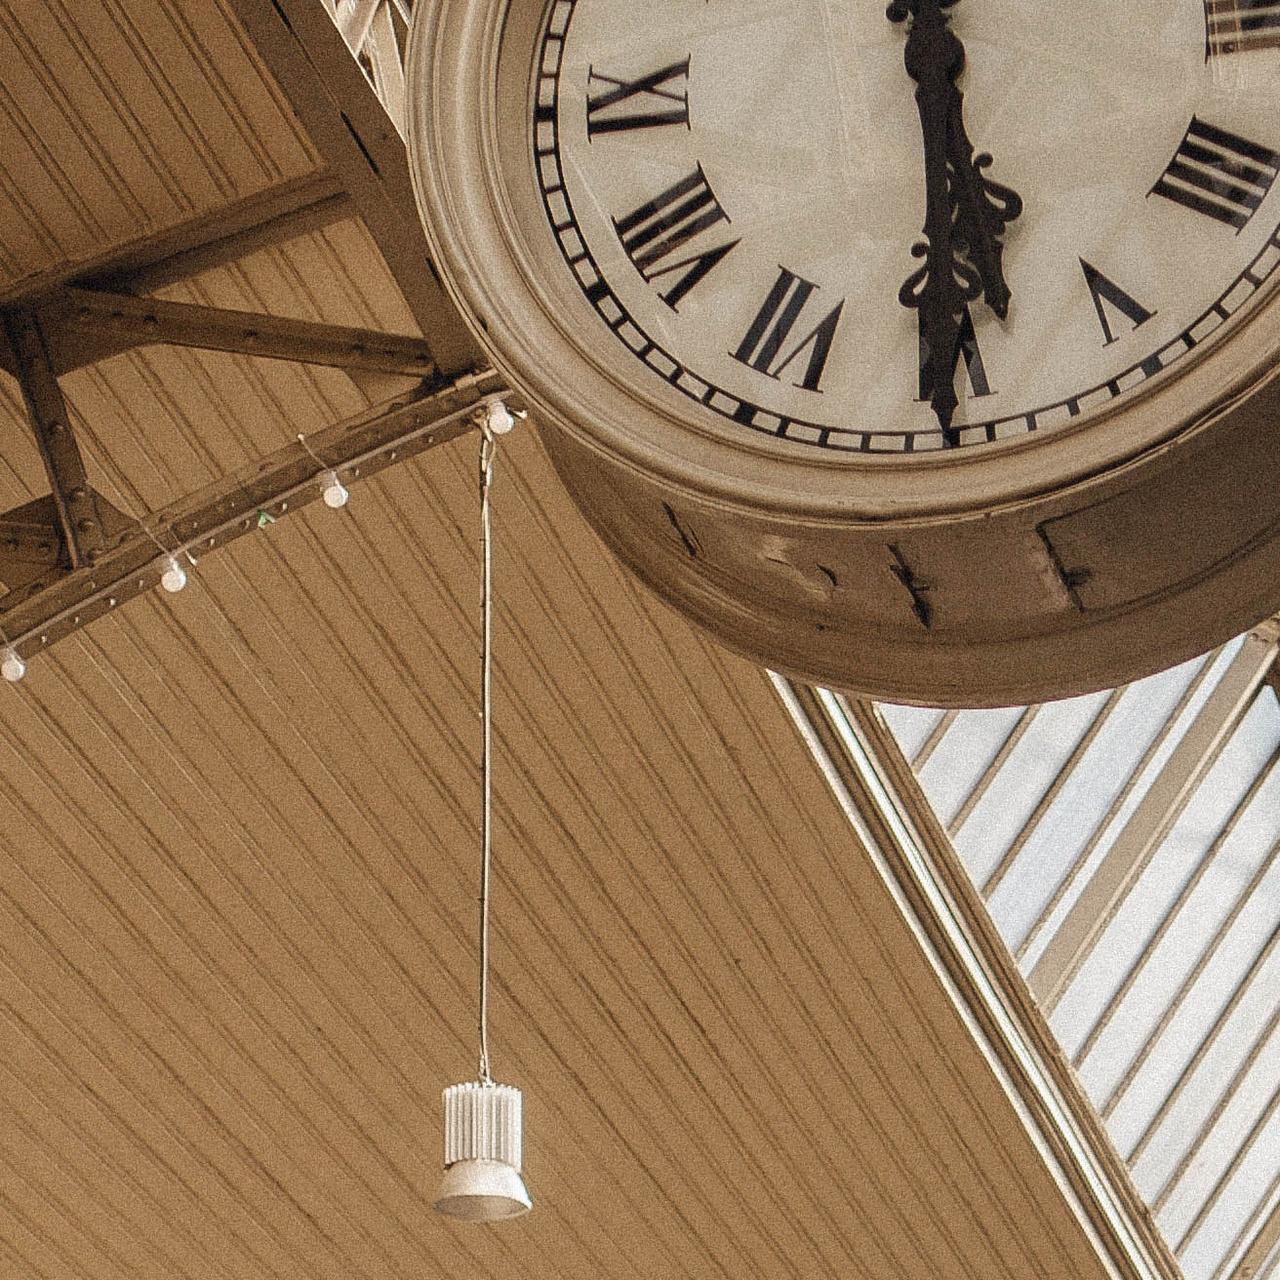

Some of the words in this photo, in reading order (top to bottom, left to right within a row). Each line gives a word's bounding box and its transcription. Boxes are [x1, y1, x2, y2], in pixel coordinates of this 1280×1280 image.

[586, 52, 692, 144] IX
[610, 160, 743, 314] VIII
[727, 264, 846, 394] VII
[1078, 256, 1158, 347] V
